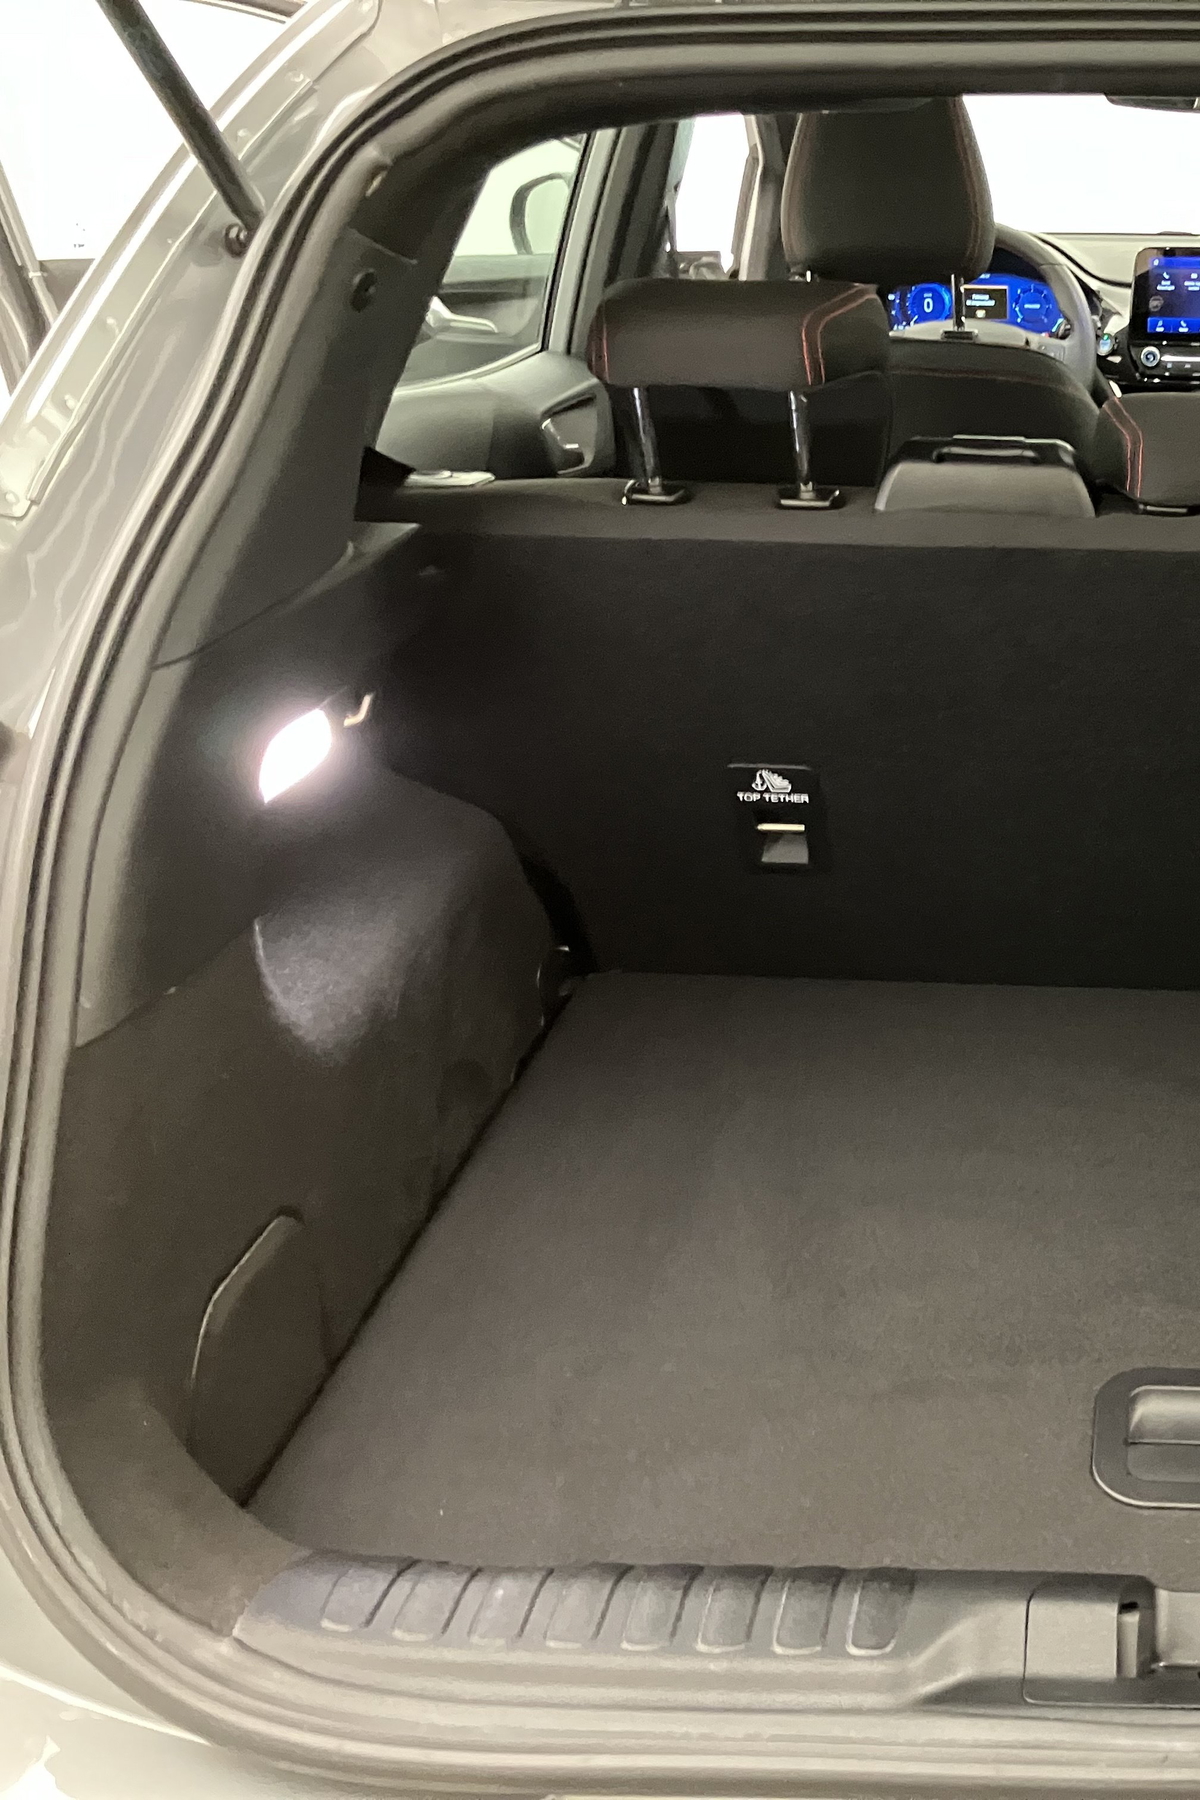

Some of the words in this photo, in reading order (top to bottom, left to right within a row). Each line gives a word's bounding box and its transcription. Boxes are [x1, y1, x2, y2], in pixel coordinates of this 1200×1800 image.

[923, 298, 933, 313] 0
[737, 791, 761, 802] TOP
[762, 792, 809, 804] TETHER
